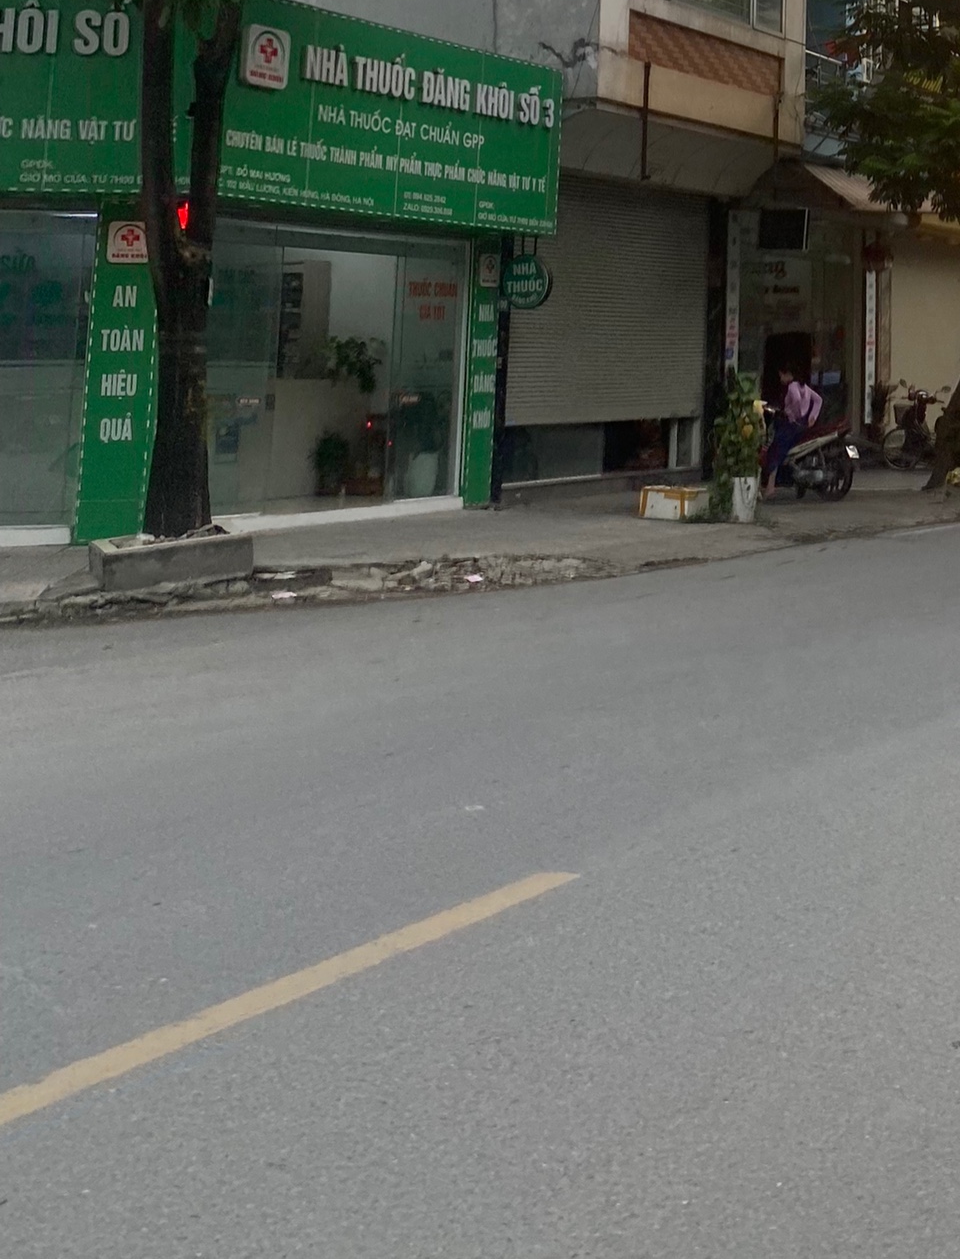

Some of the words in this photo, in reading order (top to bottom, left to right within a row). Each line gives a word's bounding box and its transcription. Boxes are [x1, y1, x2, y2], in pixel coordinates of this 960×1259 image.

[305, 44, 348, 87] NHÀ
[355, 53, 416, 100] THUỐC
[422, 68, 471, 112] ĐĂNG
[475, 82, 514, 120] KHÔI
[519, 85, 541, 126] SỐ
[543, 98, 555, 128] 3
[79, 116, 108, 145] VẬT
[113, 118, 138, 141] TƯ
[318, 104, 346, 125] NHÀ
[350, 109, 392, 133] THUỐC
[395, 119, 417, 141] ĐẠT
[420, 121, 460, 147] CHUẨN
[463, 132, 485, 149] GPP
[226, 129, 262, 151] CHUYÊN
[265, 134, 284, 154] BÁN
[287, 135, 297, 157] LẺ
[300, 139, 327, 161] THUỐC
[330, 145, 356, 166] THÀNH
[424, 162, 442, 181] THỰC
[467, 166, 486, 184] CHỨC
[509, 172, 520, 191] VẬT
[522, 175, 531, 191] TƯ
[532, 178, 537, 192] Y
[538, 175, 547, 193] TẾ
[512, 260, 537, 276] NHÀ
[112, 285, 137, 308] AN
[507, 275, 543, 293] THUỐC
[478, 301, 495, 322] NHÀ
[101, 325, 144, 352] TOÀN
[473, 334, 498, 358] THUỐC
[101, 369, 137, 400] HIỆU
[100, 412, 132, 443] QUẢ
